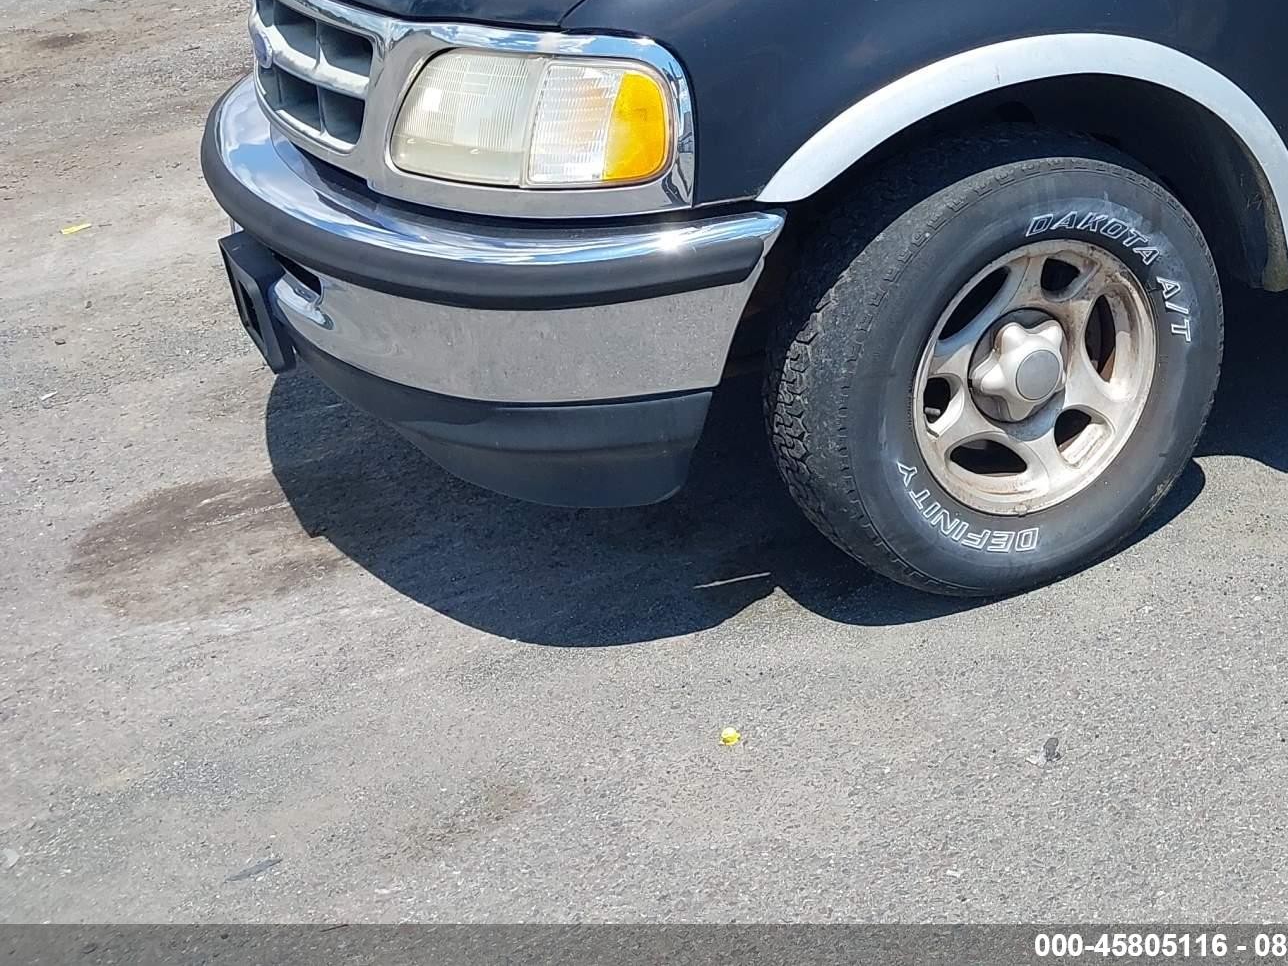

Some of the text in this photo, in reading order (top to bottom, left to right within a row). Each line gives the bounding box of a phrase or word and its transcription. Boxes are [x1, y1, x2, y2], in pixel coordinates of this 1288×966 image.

[1024, 211, 1192, 344] DAKOTA A/T
[896, 463, 1040, 554] DEFINITY
